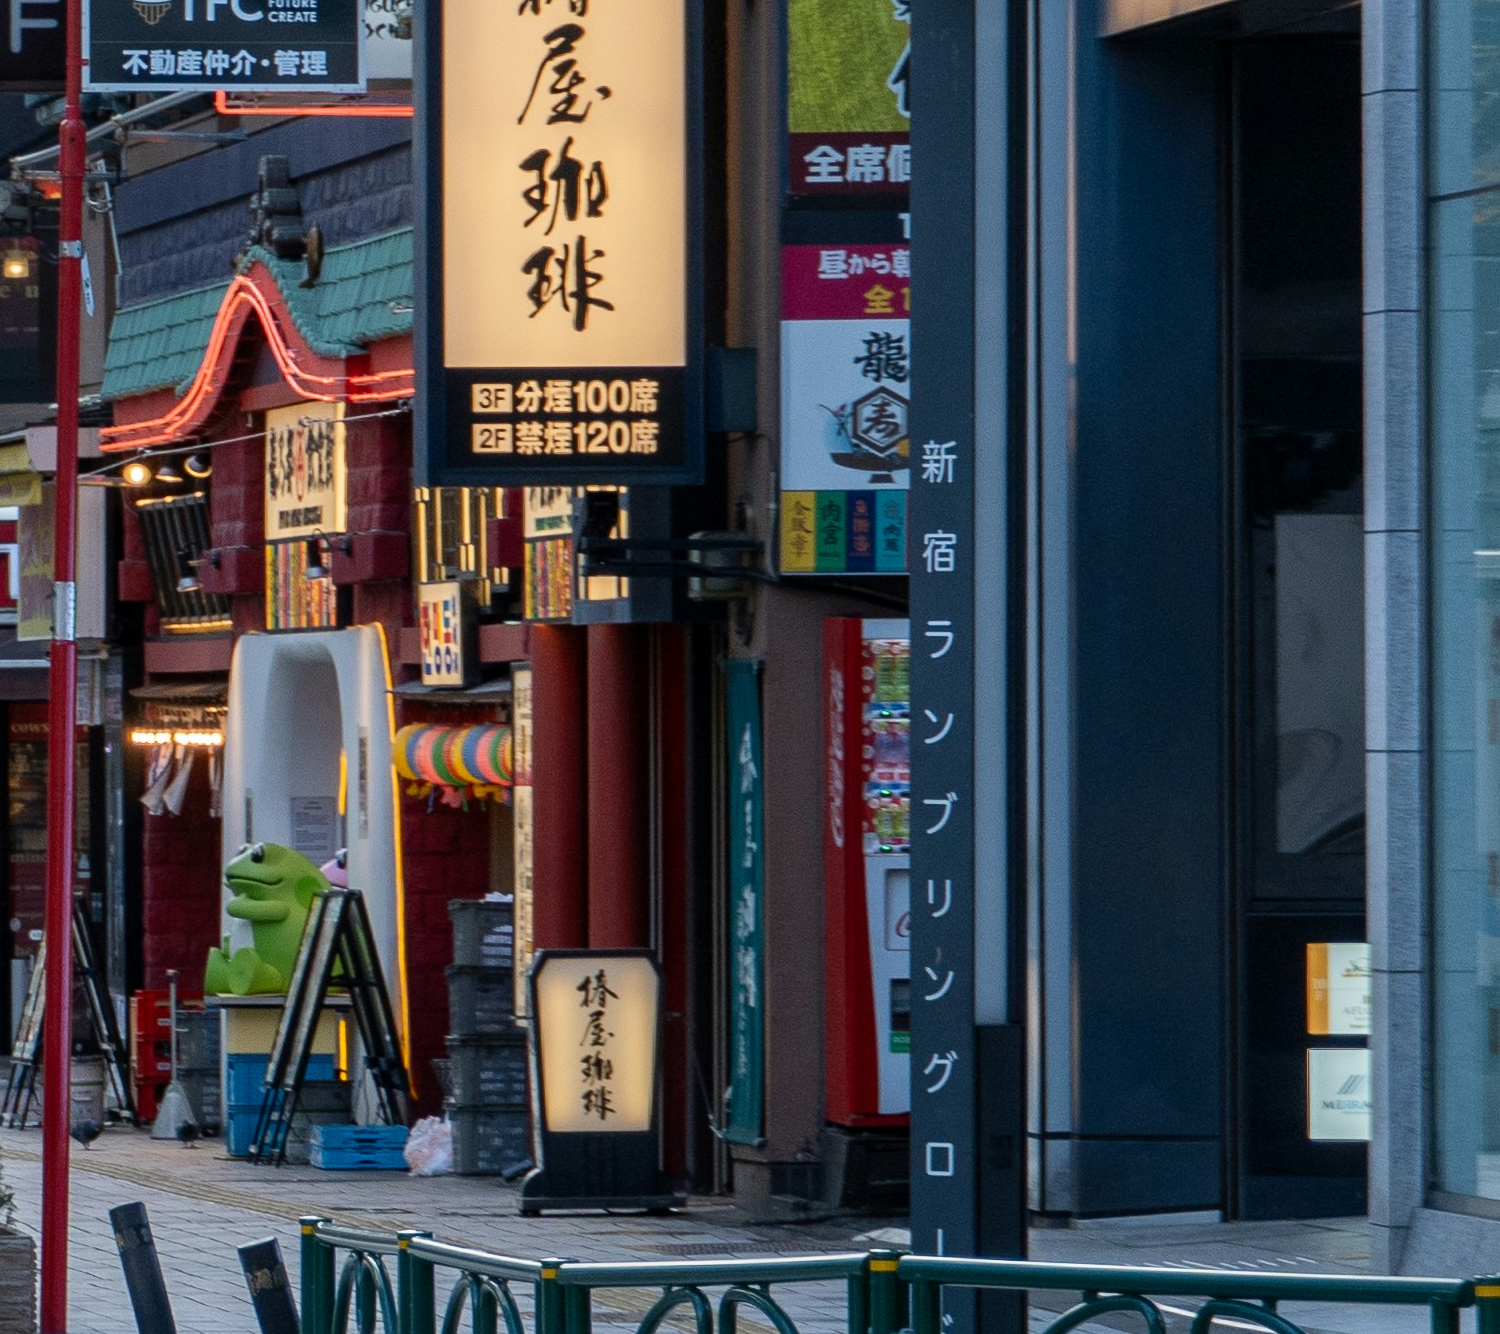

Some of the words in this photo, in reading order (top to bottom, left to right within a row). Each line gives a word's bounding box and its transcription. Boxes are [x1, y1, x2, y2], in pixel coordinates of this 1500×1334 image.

[267, 10, 318, 23] CREATE
[121, 48, 329, 78] 不動産仲介・管理
[477, 387, 507, 409] 3F
[514, 379, 660, 415] 分煙100席
[477, 427, 507, 450] 2F
[514, 419, 660, 456] 禁煙120席
[574, 968, 620, 1121] 椿屋珈琲
